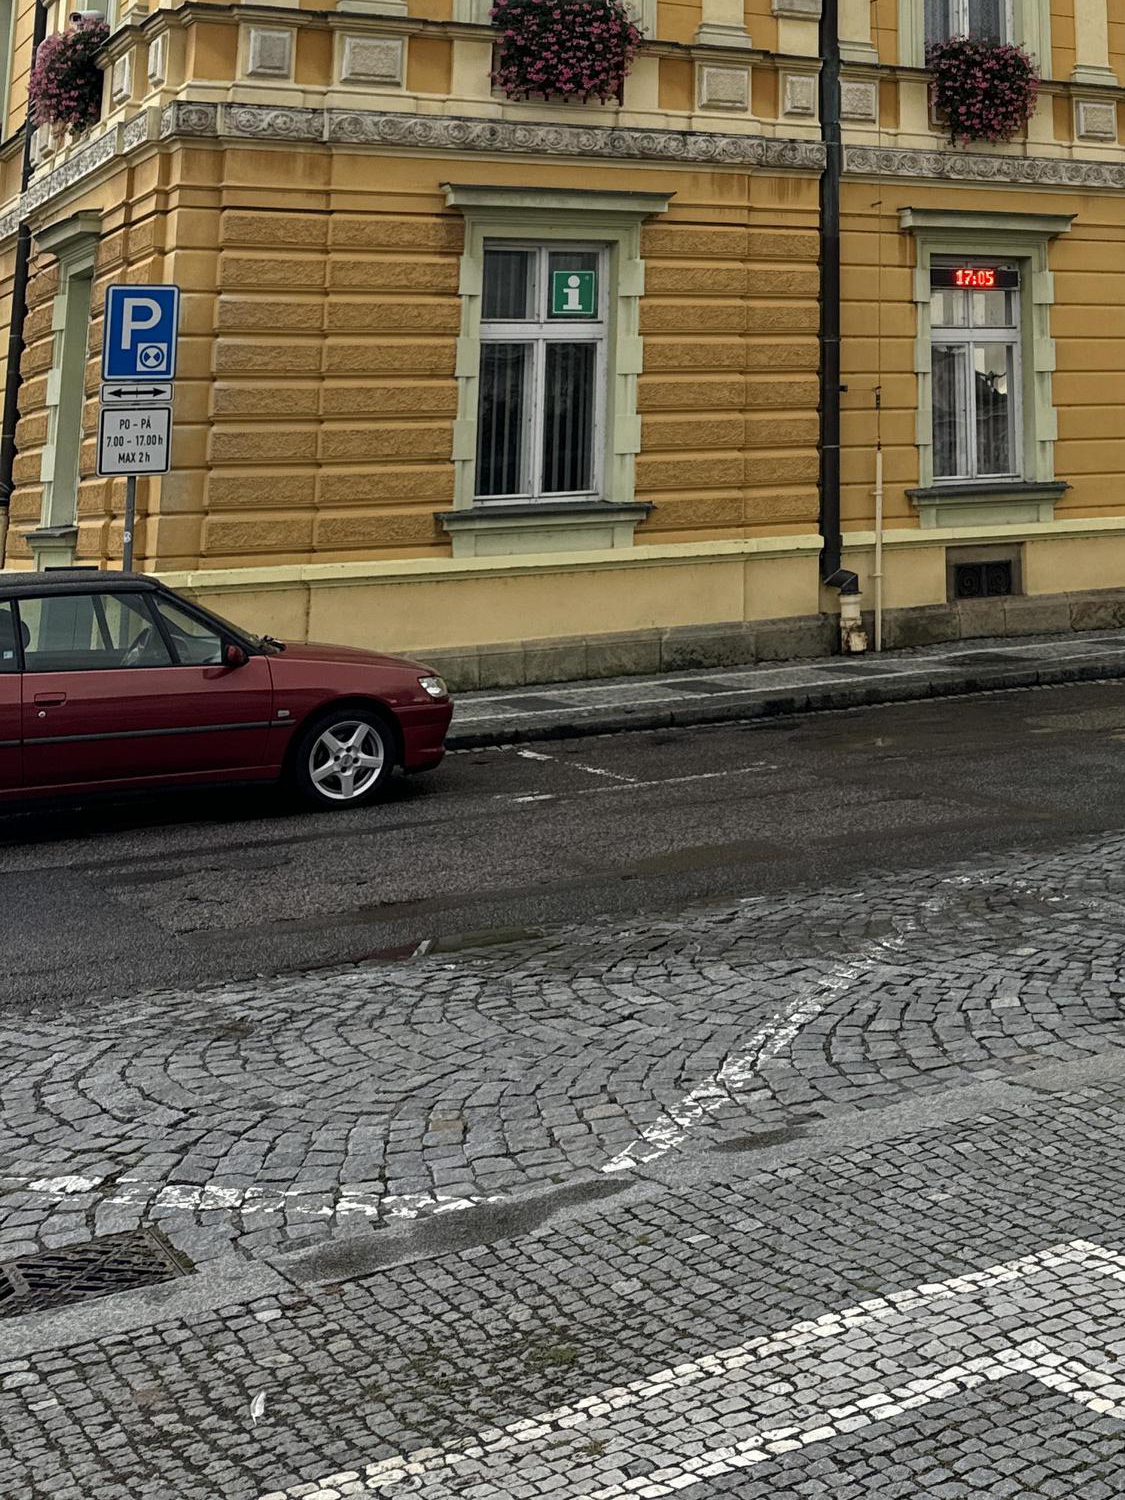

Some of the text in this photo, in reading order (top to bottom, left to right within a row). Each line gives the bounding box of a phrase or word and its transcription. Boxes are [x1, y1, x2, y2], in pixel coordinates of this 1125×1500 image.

[956, 270, 994, 285] 17:05
[121, 297, 162, 350] P
[119, 419, 130, 430] PO
[141, 415, 152, 429] PÁ
[106, 435, 124, 448] 7.00
[135, 434, 157, 446] 17.00
[118, 452, 136, 464] MAX
